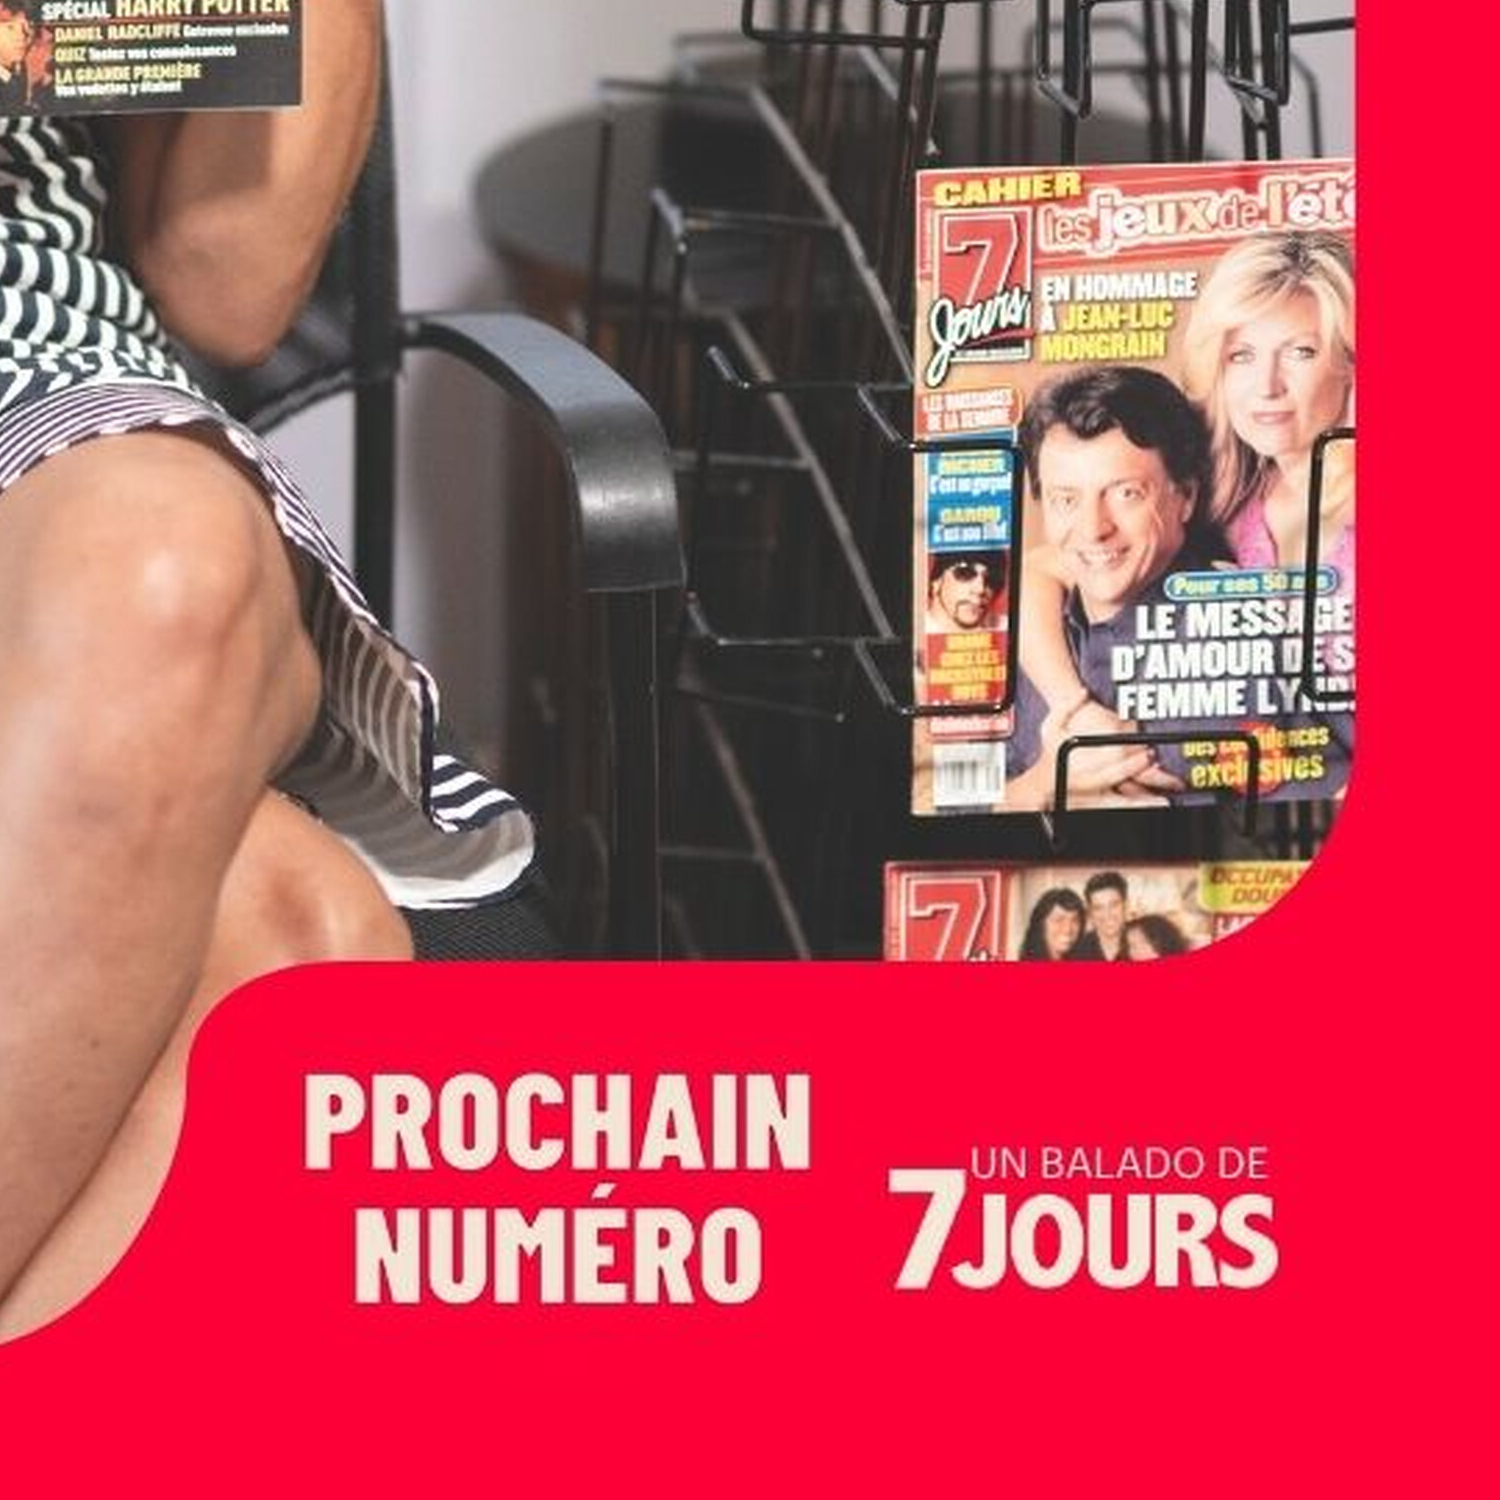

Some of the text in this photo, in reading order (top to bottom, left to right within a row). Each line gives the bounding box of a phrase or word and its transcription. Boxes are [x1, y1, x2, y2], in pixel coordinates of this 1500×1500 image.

[54, 68, 73, 85] LA
[75, 65, 131, 83] GRANDE
[934, 171, 1082, 207] CAHIER
[1045, 206, 1092, 245] les
[1097, 192, 1213, 251] jeux
[1219, 196, 1259, 229] de
[943, 214, 1021, 306] 7
[1041, 272, 1197, 301] EN HOMMAGE
[1063, 302, 1174, 331] JEAN-LUC
[1041, 333, 1166, 364] MONGRAIN
[1262, 573, 1288, 591] 50
[1136, 604, 1176, 641] LE
[1111, 637, 1275, 682] D'AMOUR
[1330, 634, 1355, 673] S
[1118, 679, 1247, 721] FEMME
